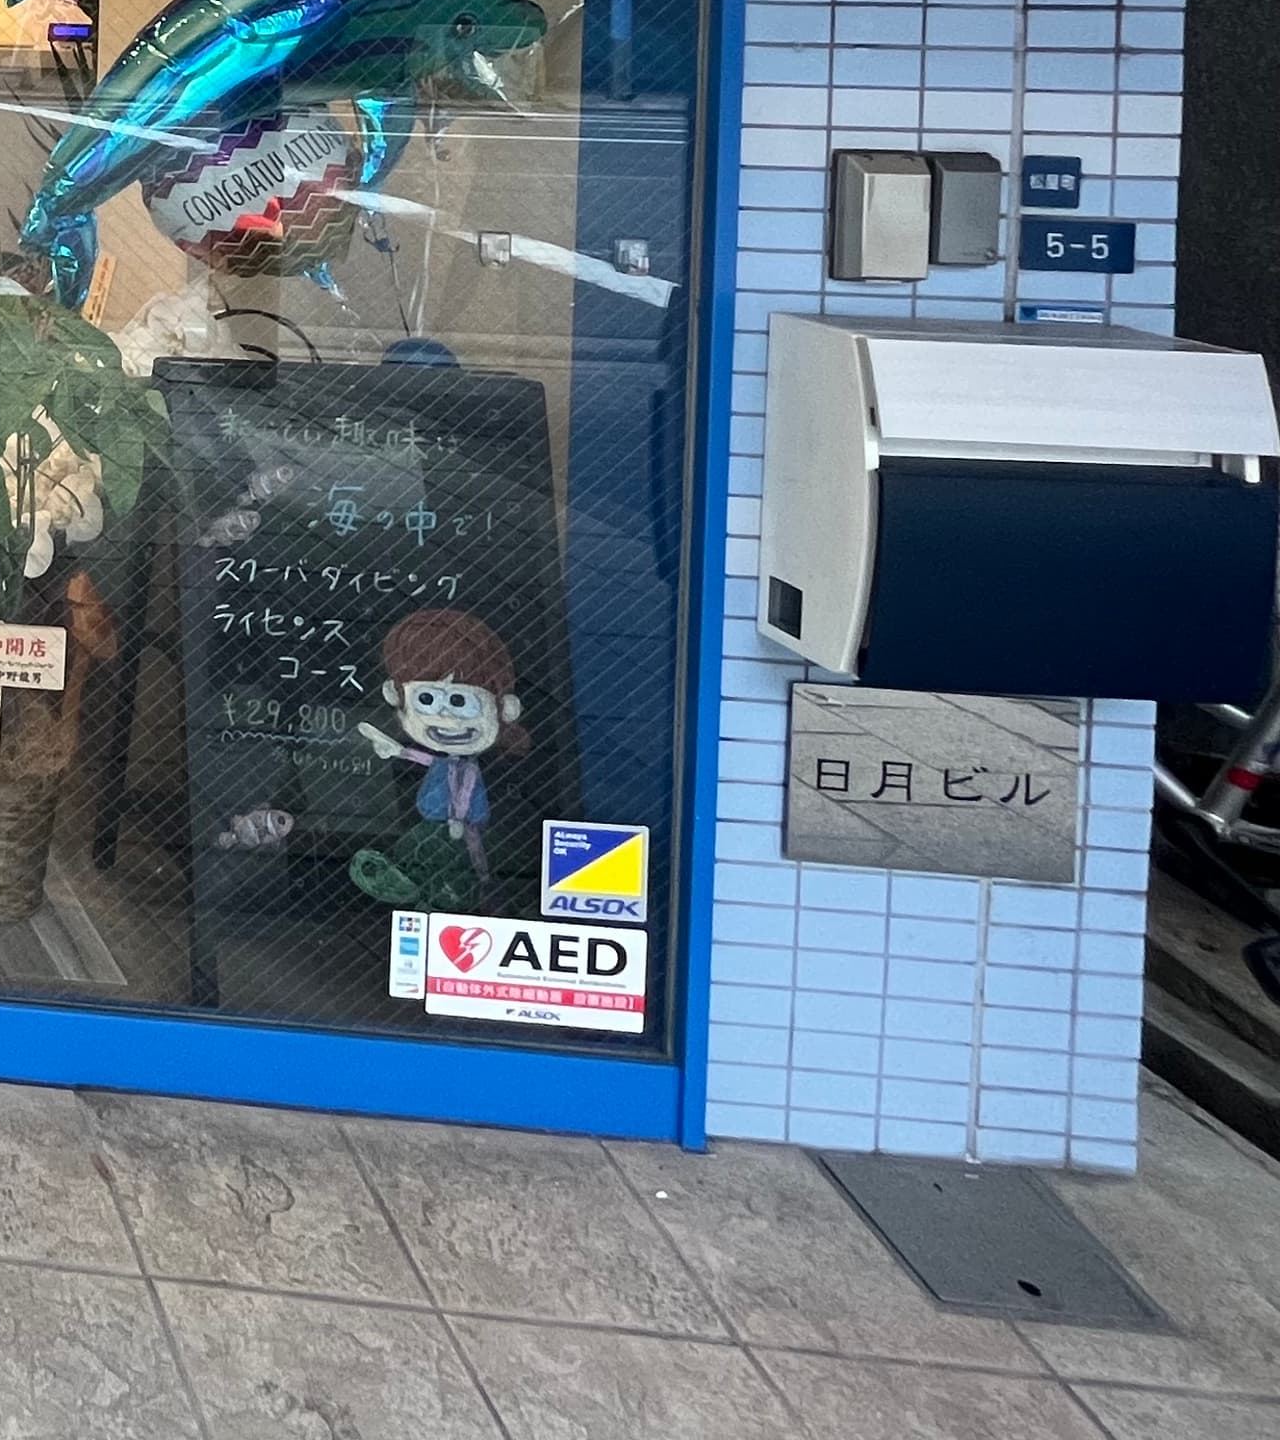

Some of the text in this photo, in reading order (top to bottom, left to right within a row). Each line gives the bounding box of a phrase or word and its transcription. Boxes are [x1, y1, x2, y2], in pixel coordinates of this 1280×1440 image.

[1046, 232, 1109, 259] 5-5
[213, 604, 352, 648] ライセンス
[277, 655, 366, 693] コース
[814, 757, 1052, 808] 日月ビル
[548, 895, 640, 917] ALSOK
[498, 931, 628, 977] AED
